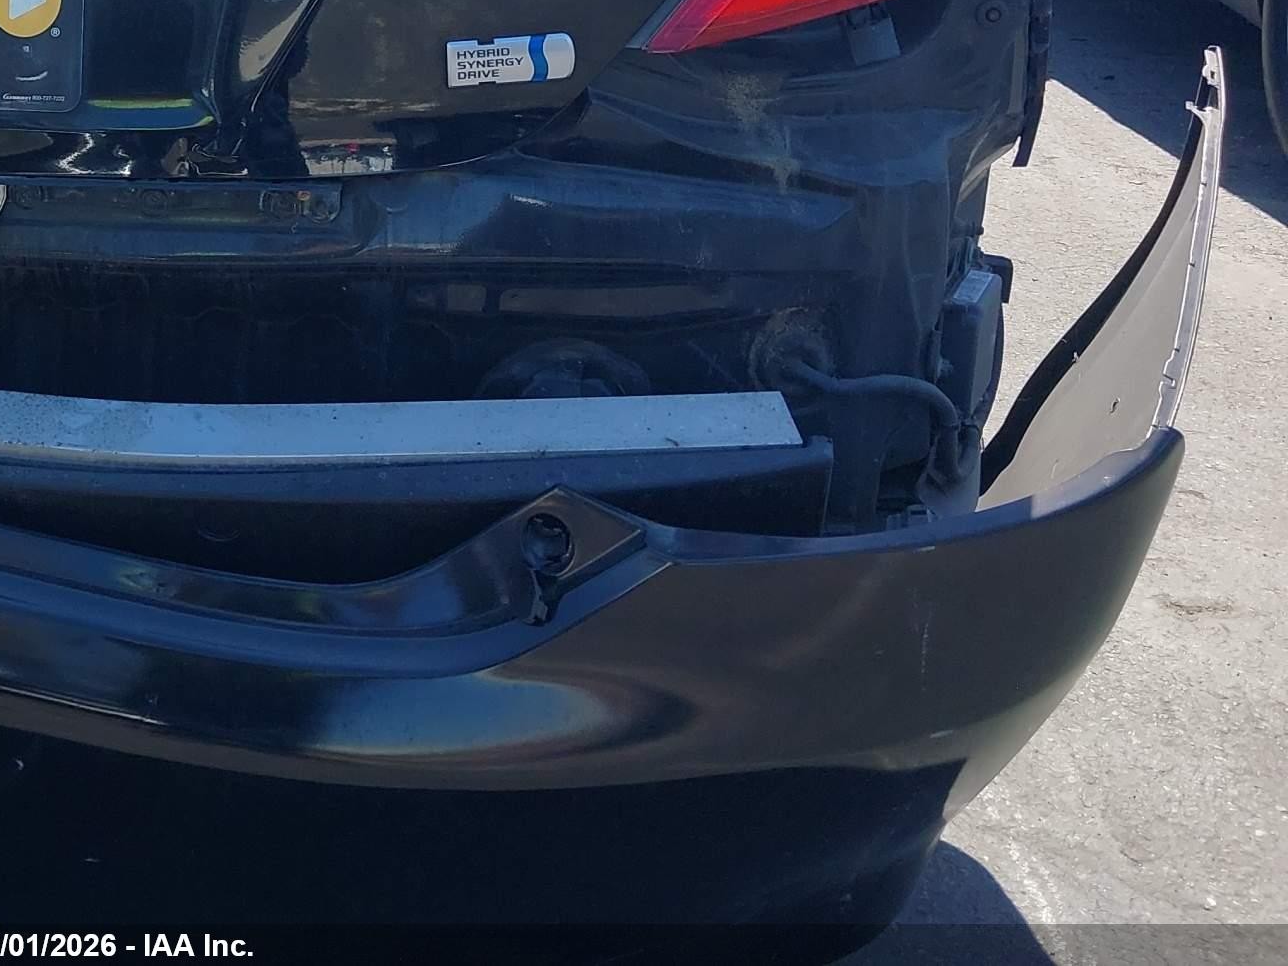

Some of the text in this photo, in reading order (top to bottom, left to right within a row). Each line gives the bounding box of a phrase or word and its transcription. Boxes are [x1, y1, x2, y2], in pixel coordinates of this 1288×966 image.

[456, 47, 511, 60] HYBRID
[456, 56, 525, 70] SYNERGY
[457, 68, 501, 80] DRIVE
